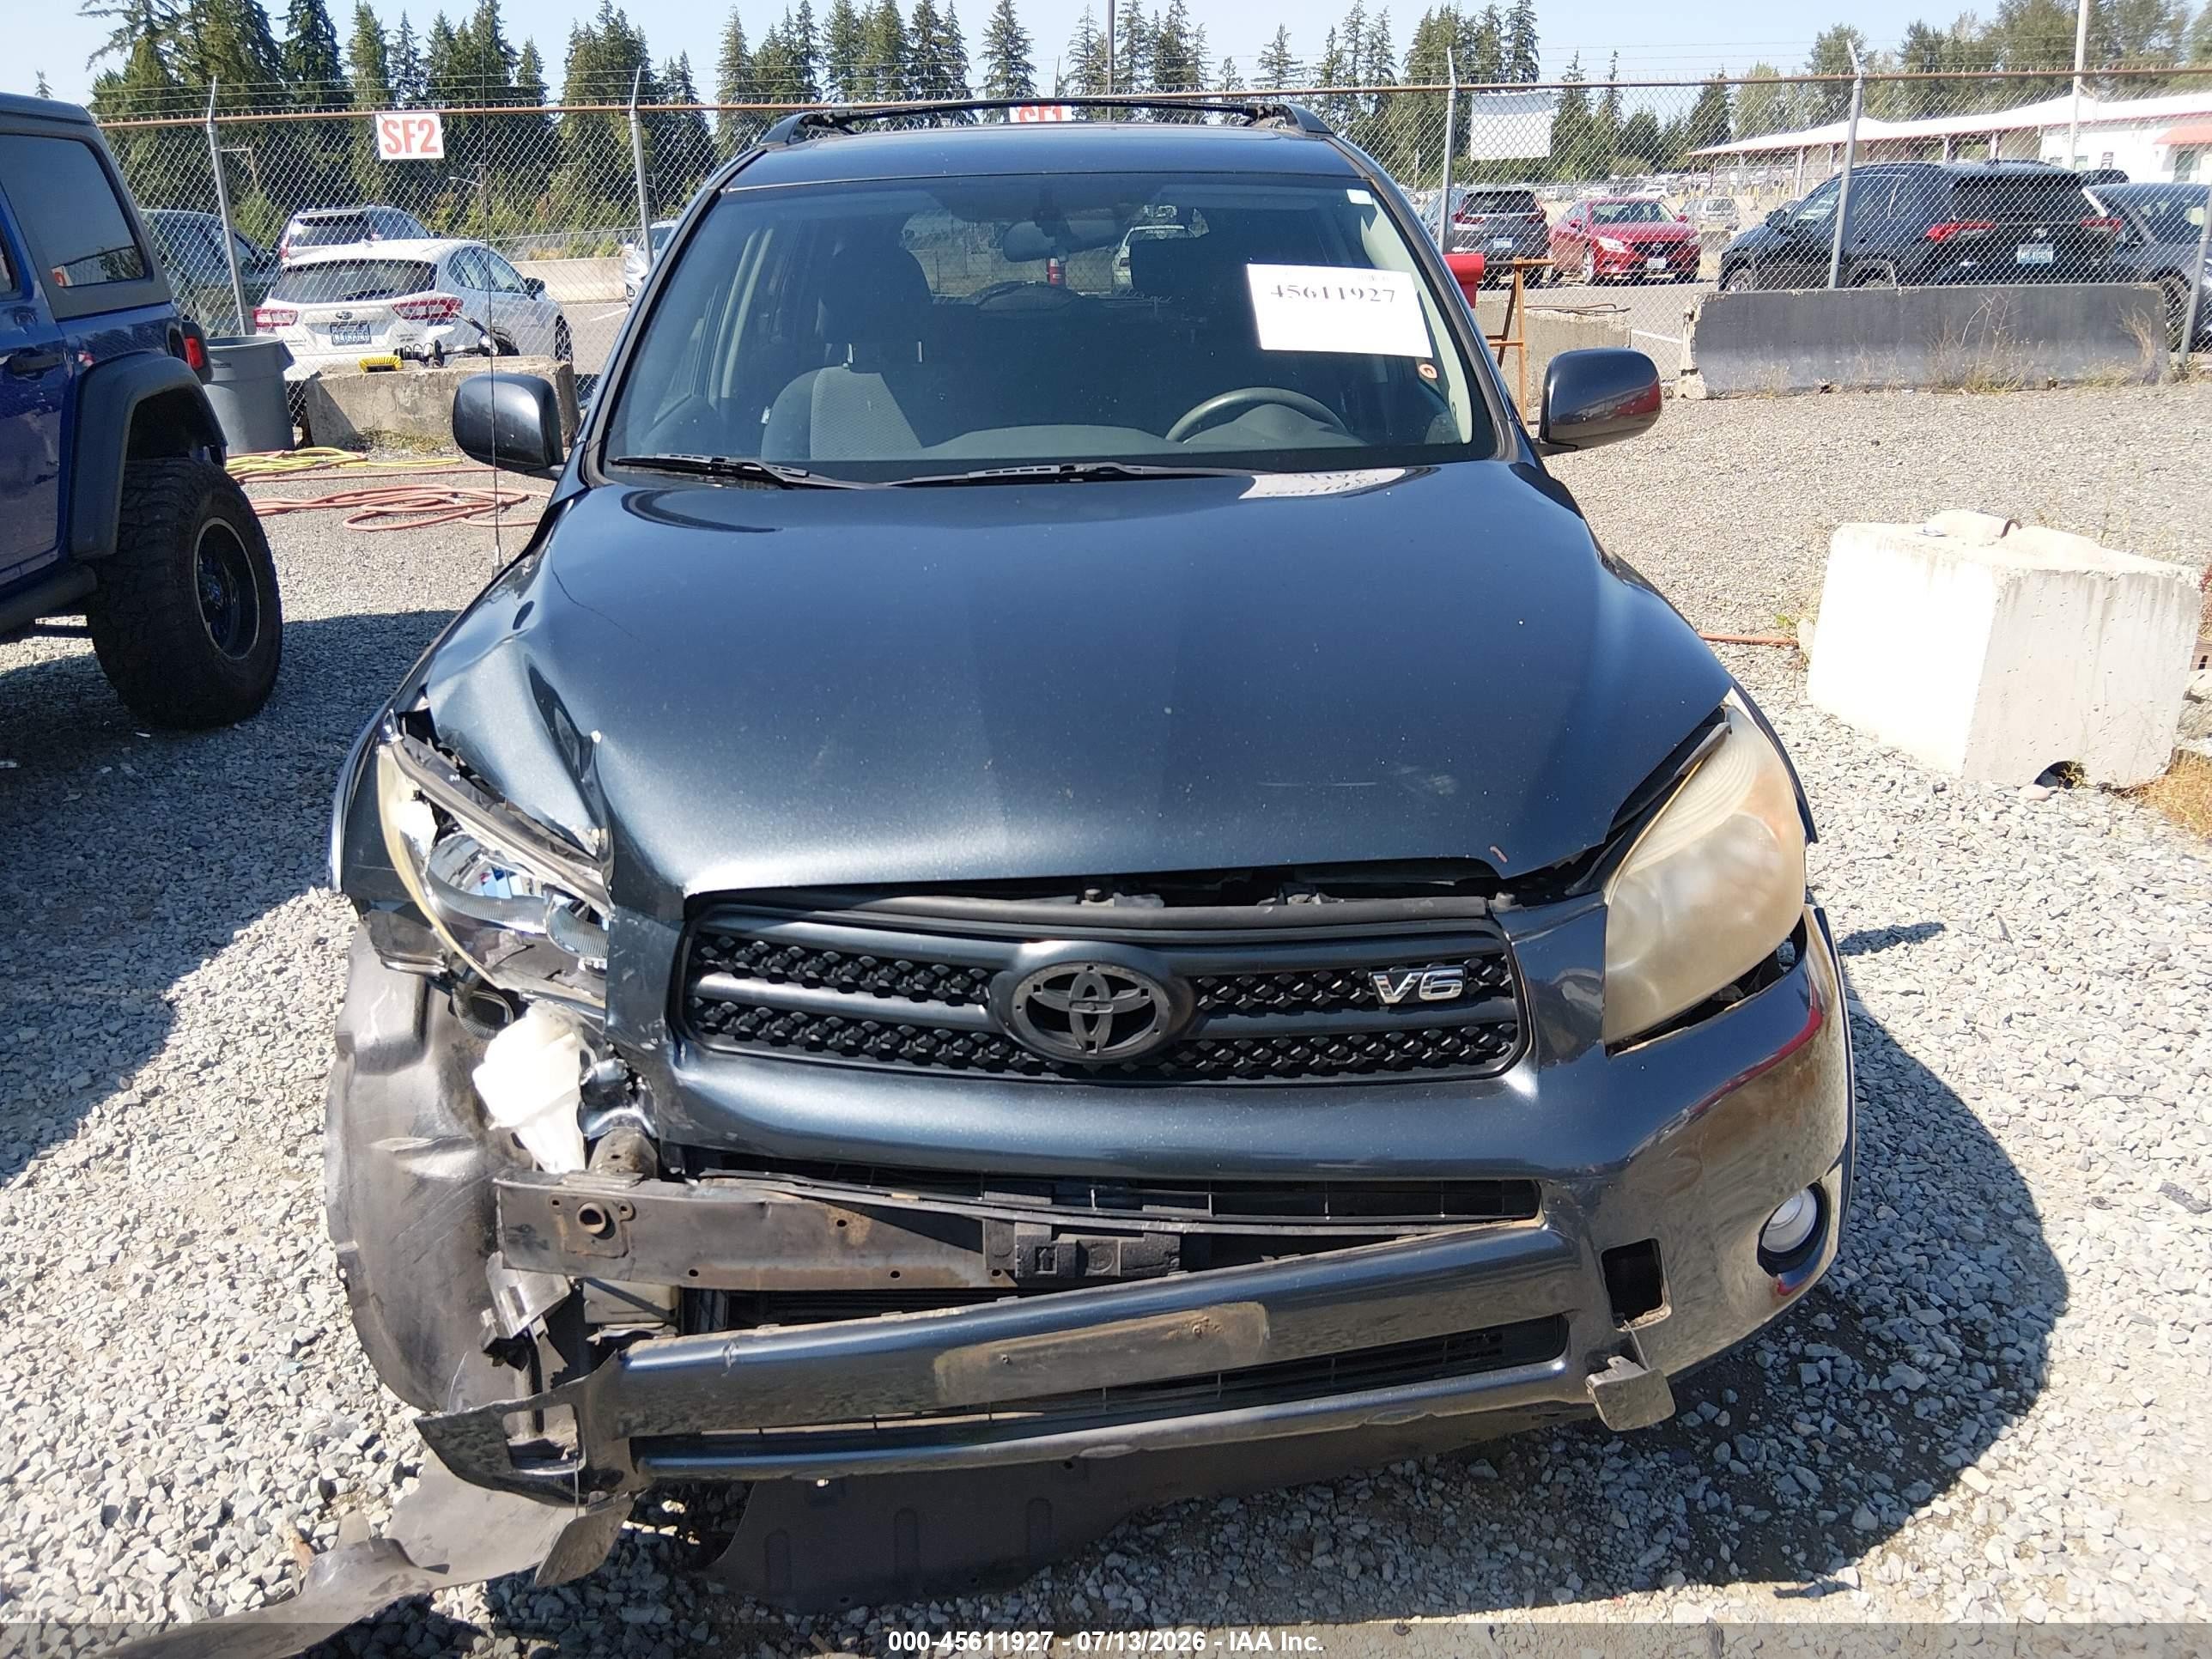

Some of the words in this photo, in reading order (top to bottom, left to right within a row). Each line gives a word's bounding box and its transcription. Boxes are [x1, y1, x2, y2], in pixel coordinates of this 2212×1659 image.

[382, 118, 438, 155] SF2
[1271, 284, 1395, 303] 45611927
[1372, 967, 1464, 1004] V6
